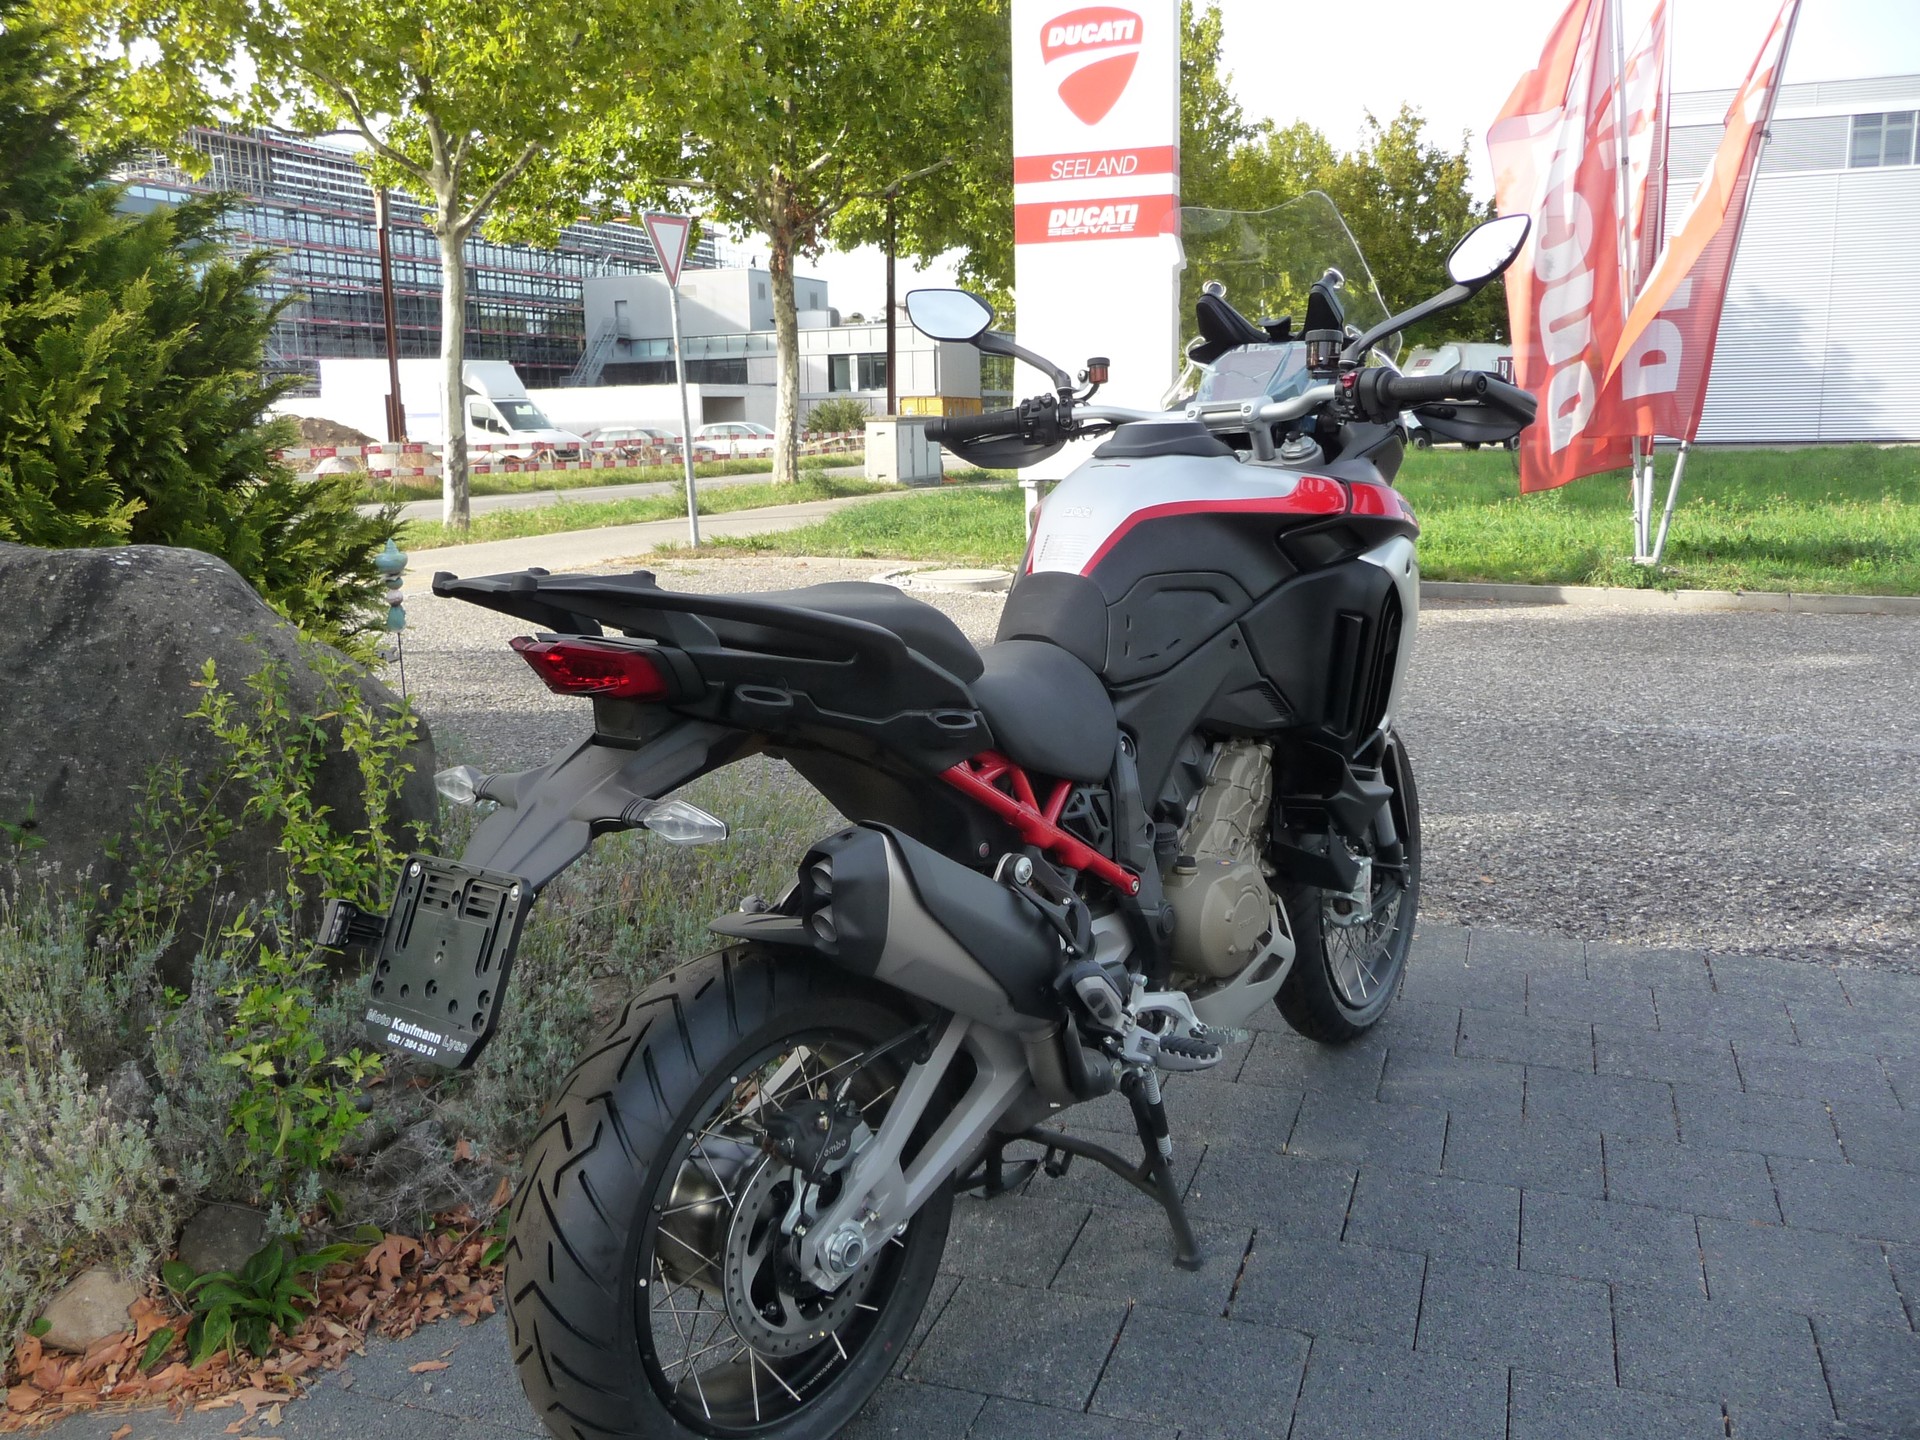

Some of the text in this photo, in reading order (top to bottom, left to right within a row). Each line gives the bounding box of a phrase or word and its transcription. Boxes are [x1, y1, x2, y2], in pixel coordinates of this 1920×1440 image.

[1047, 19, 1136, 47] DUCATI
[1050, 155, 1138, 180] SEELAND
[1048, 203, 1139, 228] DUCATI
[1047, 223, 1135, 237] SERVICE
[366, 1008, 468, 1054] Moto Kaufmann Lyss
